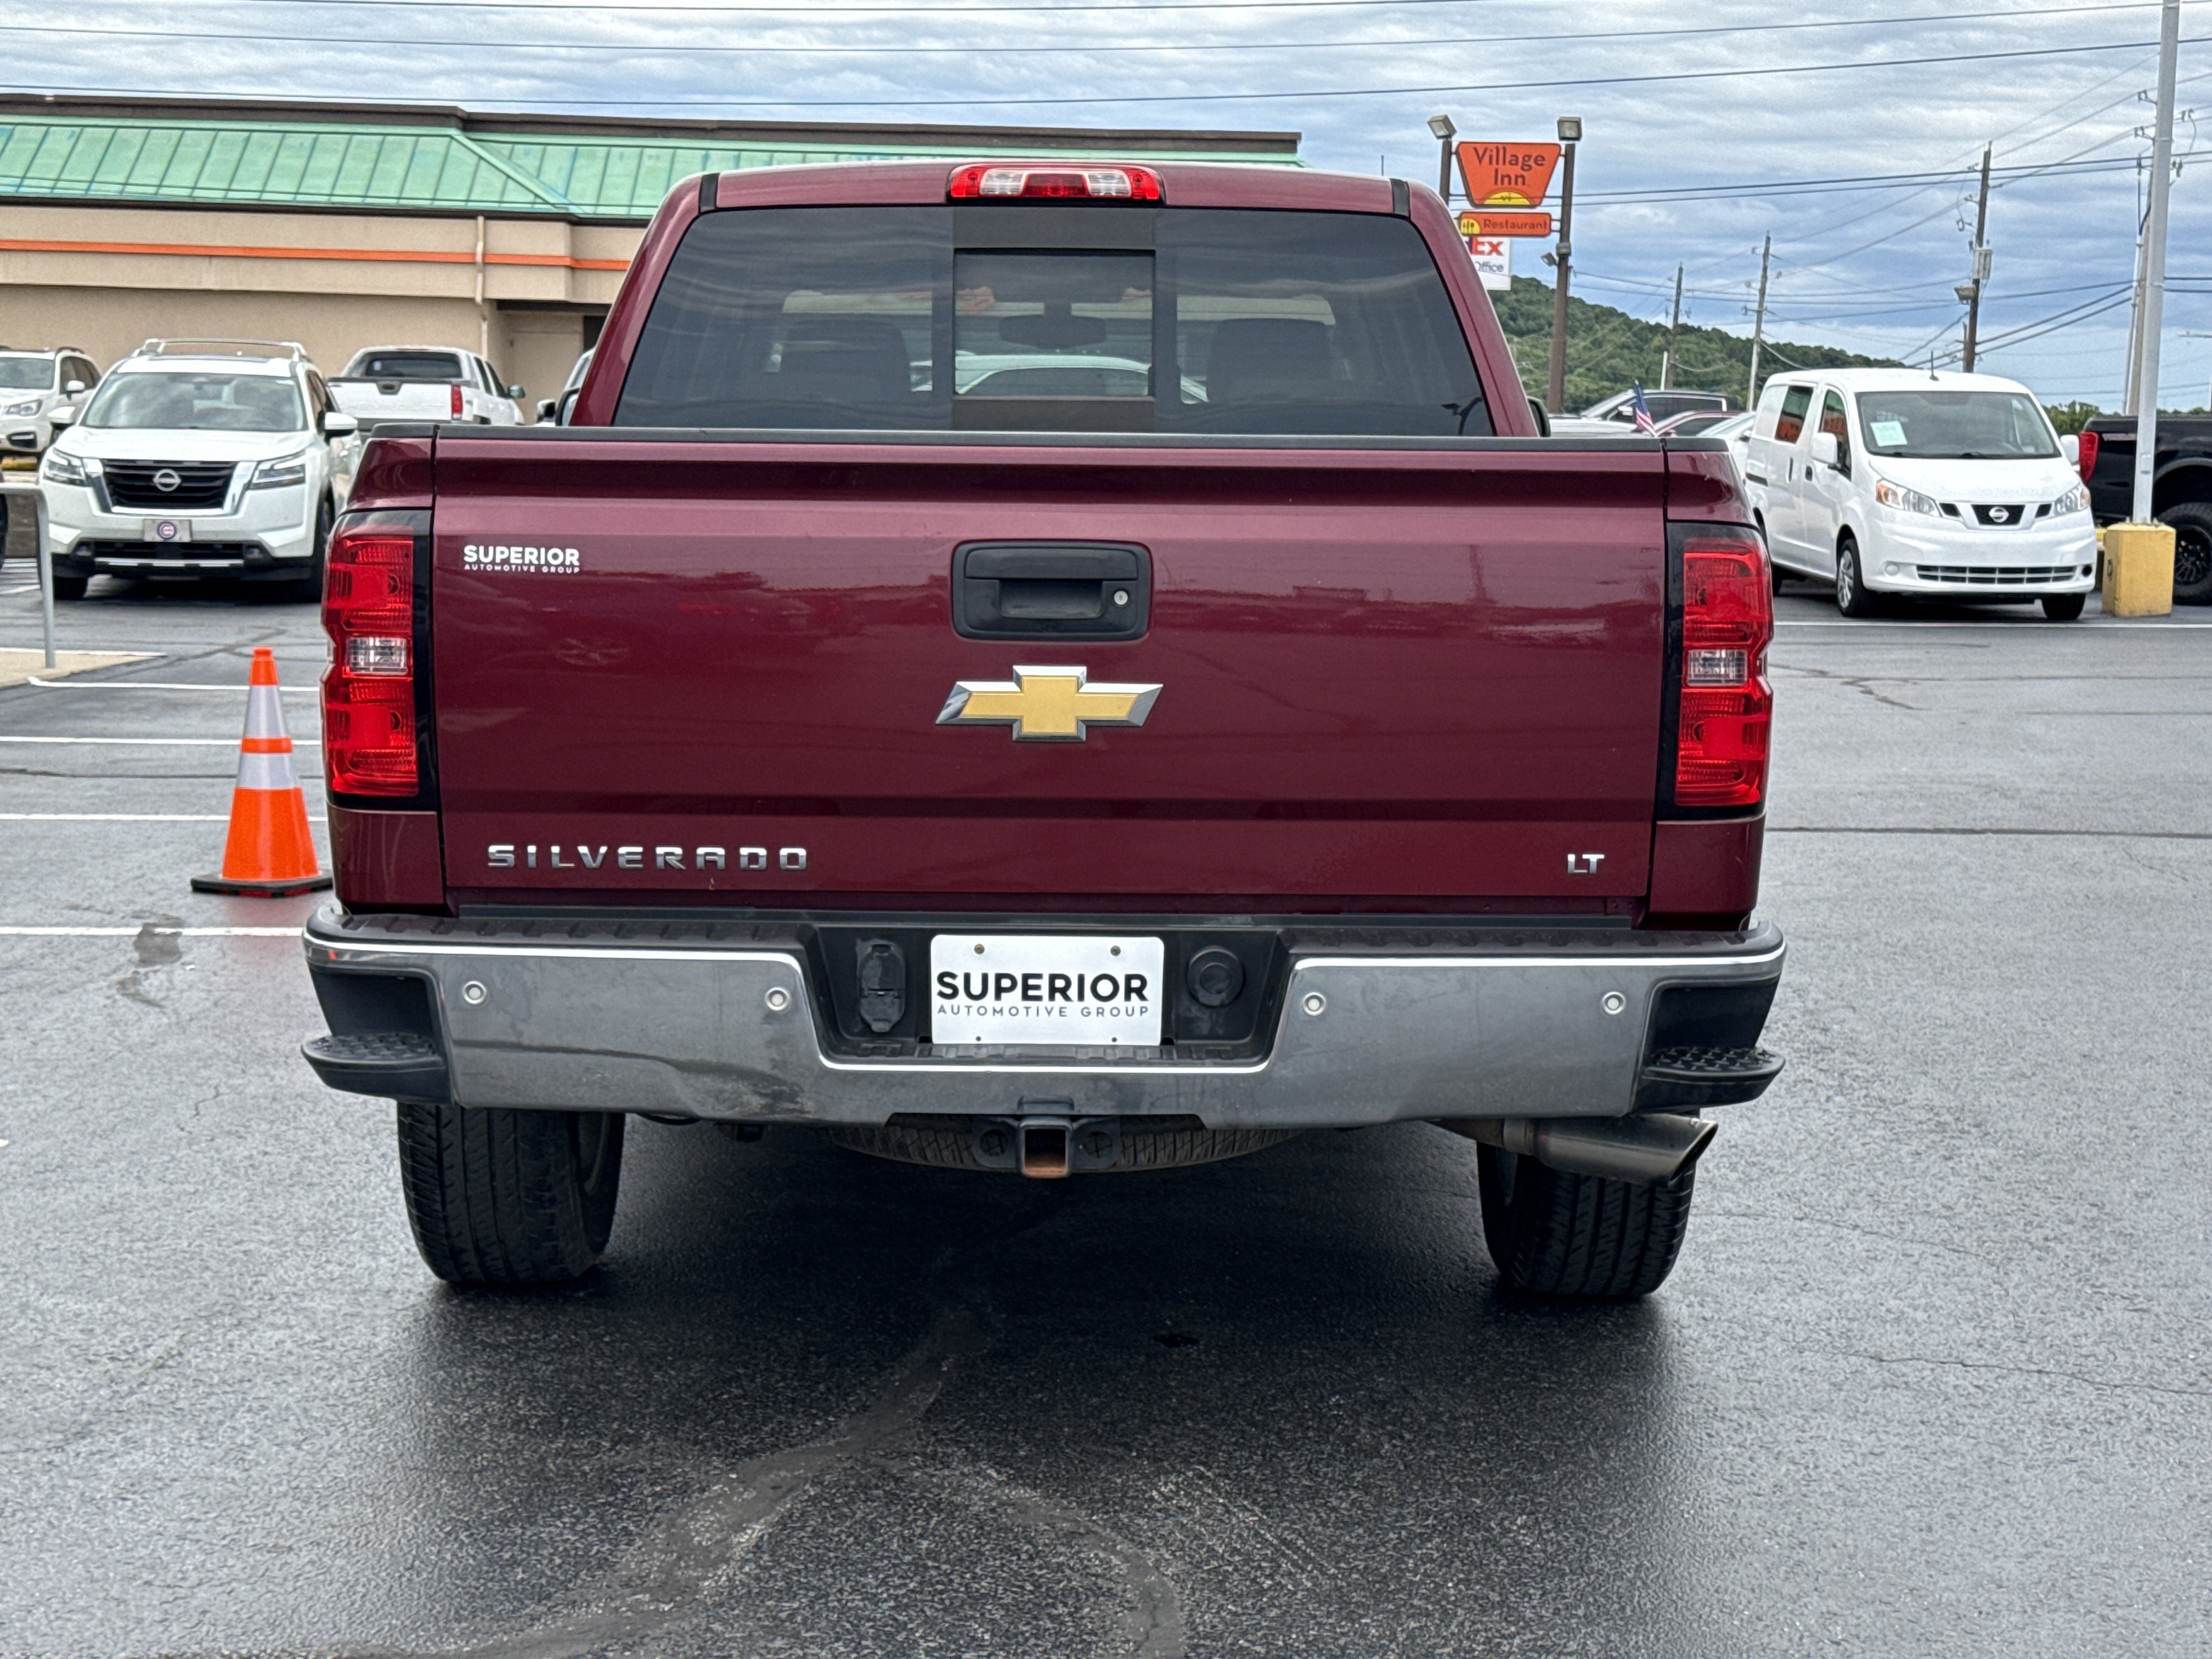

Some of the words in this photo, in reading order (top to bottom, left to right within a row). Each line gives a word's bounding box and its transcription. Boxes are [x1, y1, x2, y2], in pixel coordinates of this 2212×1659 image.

[1473, 145, 1546, 171] Village
[1493, 168, 1526, 186] Inn
[1483, 219, 1548, 230] Restaurant
[464, 545, 579, 566] SUPERIOR
[464, 564, 535, 573] AUTOMOTIVE
[541, 566, 580, 574] GROUP
[487, 845, 807, 870] SILVERADO
[1567, 854, 1605, 874] LT
[936, 971, 1149, 1002] SUPERIOR
[937, 1005, 1067, 1017] AUTOMOTIVE
[1081, 1006, 1149, 1018] GROUP
